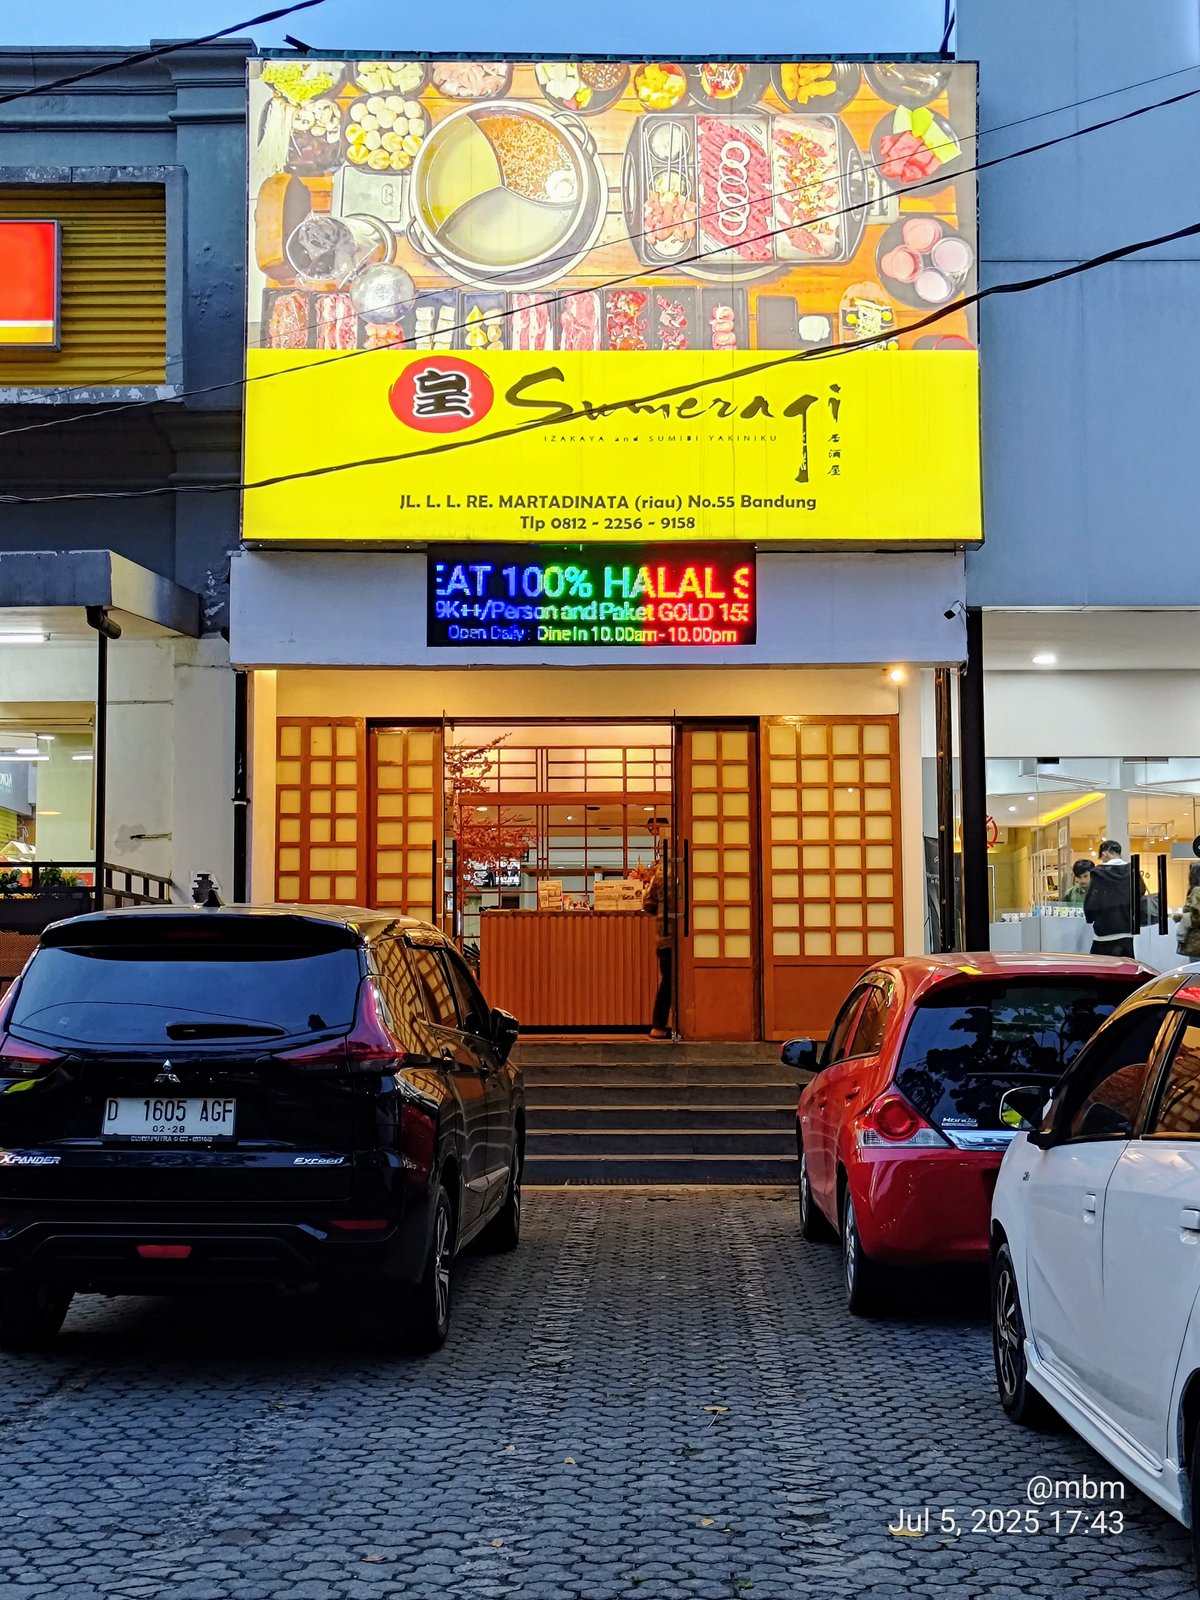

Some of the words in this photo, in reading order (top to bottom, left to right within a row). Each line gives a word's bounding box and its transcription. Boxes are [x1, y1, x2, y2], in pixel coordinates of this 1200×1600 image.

[504, 366, 842, 484] Sumeragi
[544, 435, 605, 443] IZAKAYA
[614, 435, 639, 443] and
[648, 435, 700, 443] SUMIBI
[708, 434, 777, 443] YAKINIKU
[400, 494, 421, 510] JL.
[426, 494, 441, 509] L.
[446, 494, 461, 509] L.
[466, 495, 493, 509] RE.
[498, 495, 630, 509] MARTADINATA
[634, 495, 683, 512] (riau)
[688, 495, 735, 509] No.55
[740, 494, 817, 511] Bandung
[520, 515, 546, 532] Tlp
[550, 517, 587, 530] 0812
[604, 517, 643, 530] 2256
[660, 516, 696, 530] 9158
[502, 565, 593, 598] 100%
[604, 566, 726, 599] HALAL
[599, 601, 655, 622] Paket
[658, 602, 714, 622] GOLD
[449, 625, 487, 640] Open
[591, 626, 657, 642] 10.00am
[668, 626, 737, 644] 10.00pm
[107, 1100, 119, 1122] D
[144, 1099, 188, 1122] 1605
[199, 1100, 234, 1123] AGF
[0, 1153, 62, 1164] XPANDER
